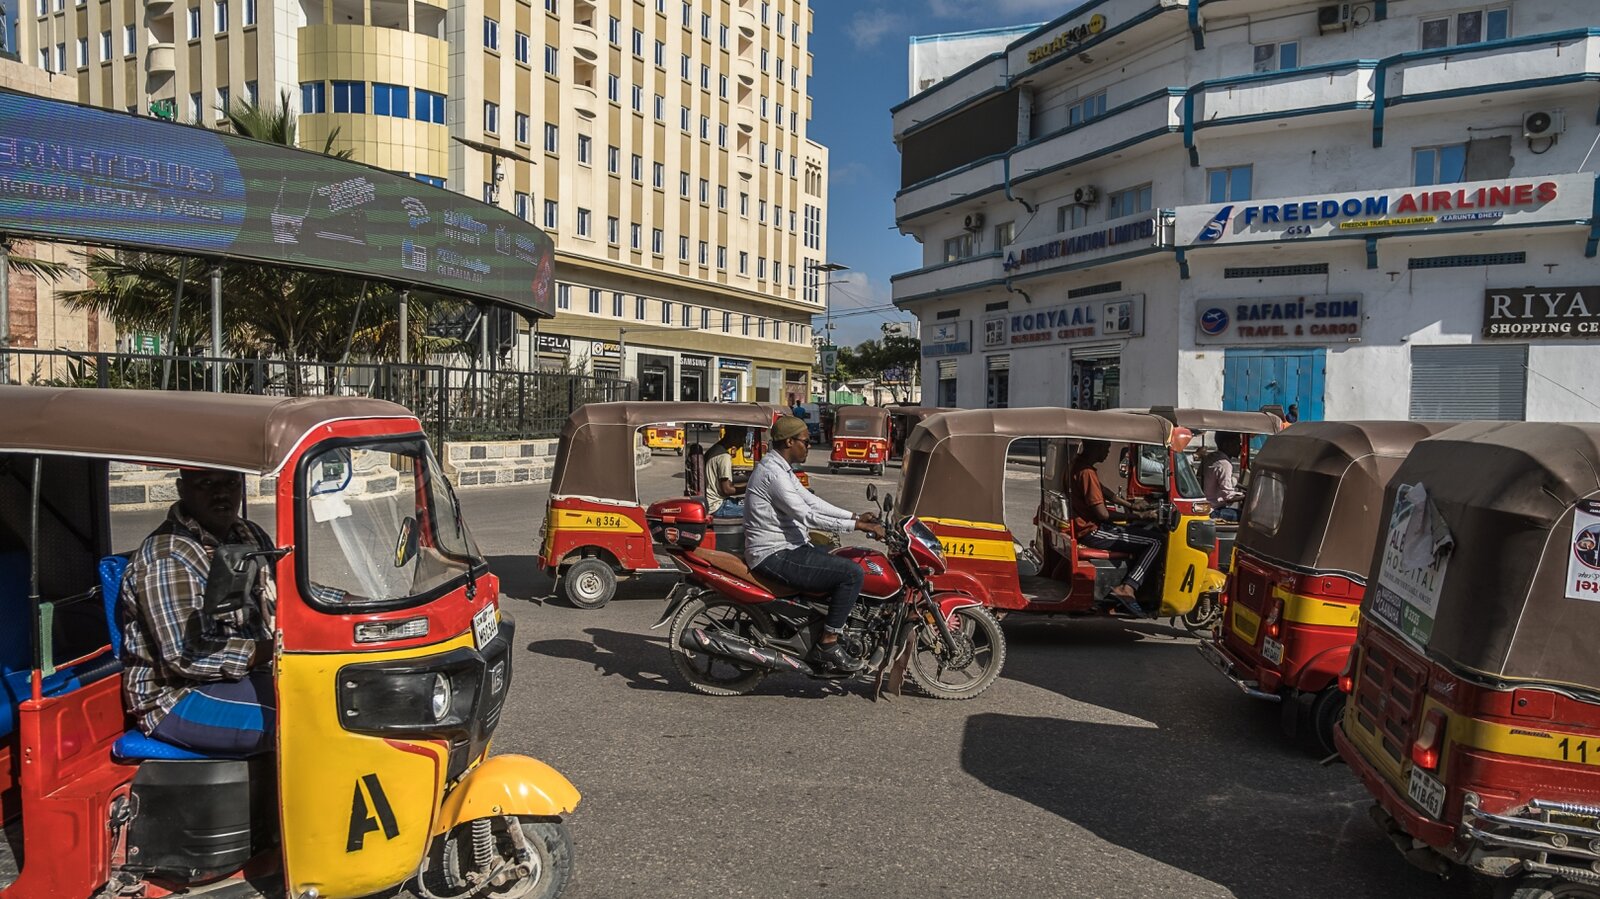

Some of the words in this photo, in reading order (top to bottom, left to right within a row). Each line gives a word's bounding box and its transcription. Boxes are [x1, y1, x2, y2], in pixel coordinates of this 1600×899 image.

[0, 176, 68, 199] ternet
[170, 196, 223, 220] Voice
[1245, 195, 1388, 226] FREEDOM
[1397, 182, 1557, 214] AIRLINES
[1341, 221, 1368, 229] FREEDOM
[1370, 219, 1388, 227] TRAVEL
[1412, 216, 1434, 224] UMRAH
[1442, 212, 1476, 221] XARUNTA
[1061, 229, 1107, 257] AVIATION
[1108, 217, 1156, 247] LIMITED
[1287, 225, 1312, 236] GSA
[1490, 291, 1600, 318] RIYA
[1011, 306, 1096, 332] HORYAAL
[1238, 325, 1288, 337] TRAVEL
[1294, 324, 1303, 336] &
[1310, 322, 1358, 336] CARGO
[1490, 322, 1572, 334] SHOPPING
[1577, 321, 1600, 333] CE
[680, 357, 707, 367] SAMSUNG
[586, 516, 592, 524] A
[596, 515, 620, 528] 8354
[943, 542, 975, 556] 4142
[1179, 564, 1195, 593] A
[1575, 579, 1600, 594] tel
[1558, 737, 1600, 764] 11
[345, 772, 400, 854] A
